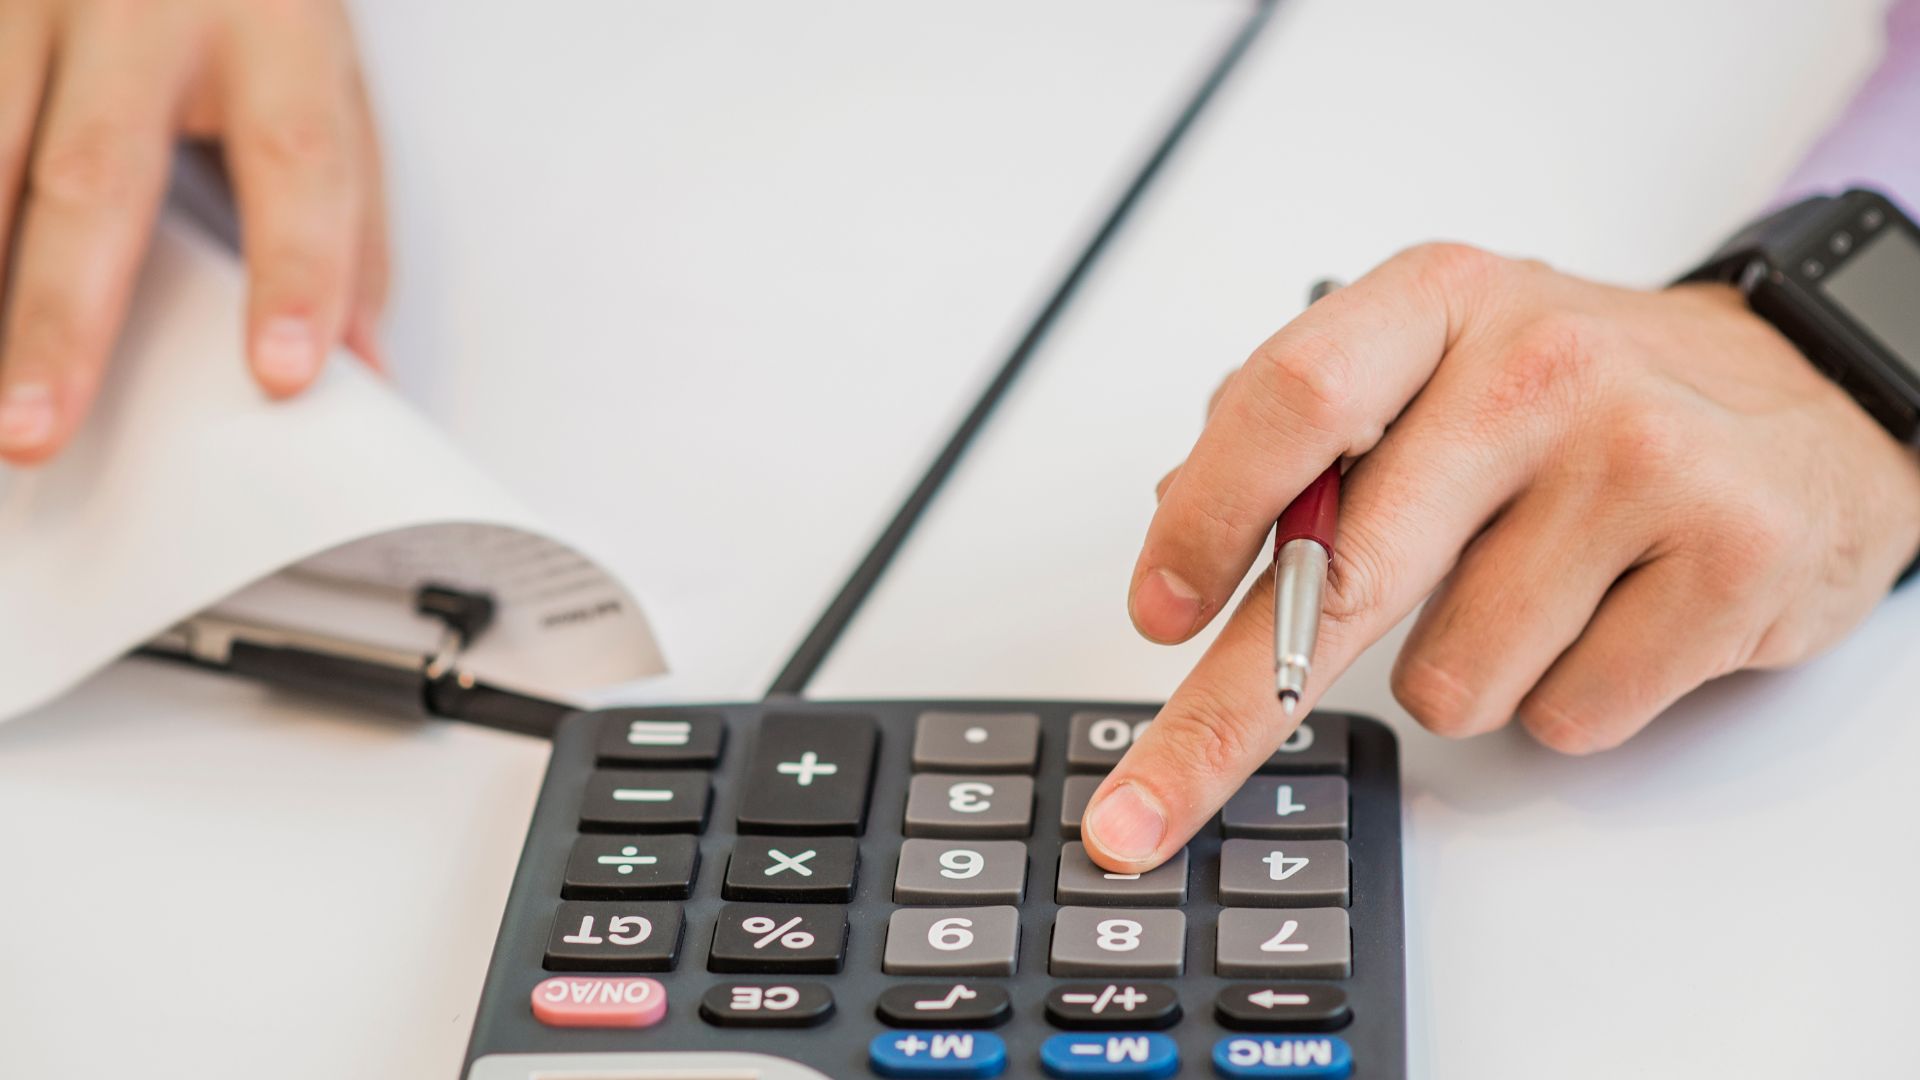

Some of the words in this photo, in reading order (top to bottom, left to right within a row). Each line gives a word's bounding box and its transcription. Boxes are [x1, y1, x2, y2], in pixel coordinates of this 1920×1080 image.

[948, 782, 994, 813] 3
[1276, 784, 1306, 816] 1
[938, 849, 985, 880] 6
[1261, 850, 1310, 881] 4
[562, 914, 653, 946] GT
[741, 916, 815, 950] %
[927, 916, 975, 951] 9
[1095, 918, 1145, 952] 8
[1259, 919, 1310, 953] 7
[545, 981, 651, 1003] ON/AC
[729, 986, 801, 1011] CE
[895, 1033, 974, 1059] M+
[1228, 1039, 1333, 1067] MRC
